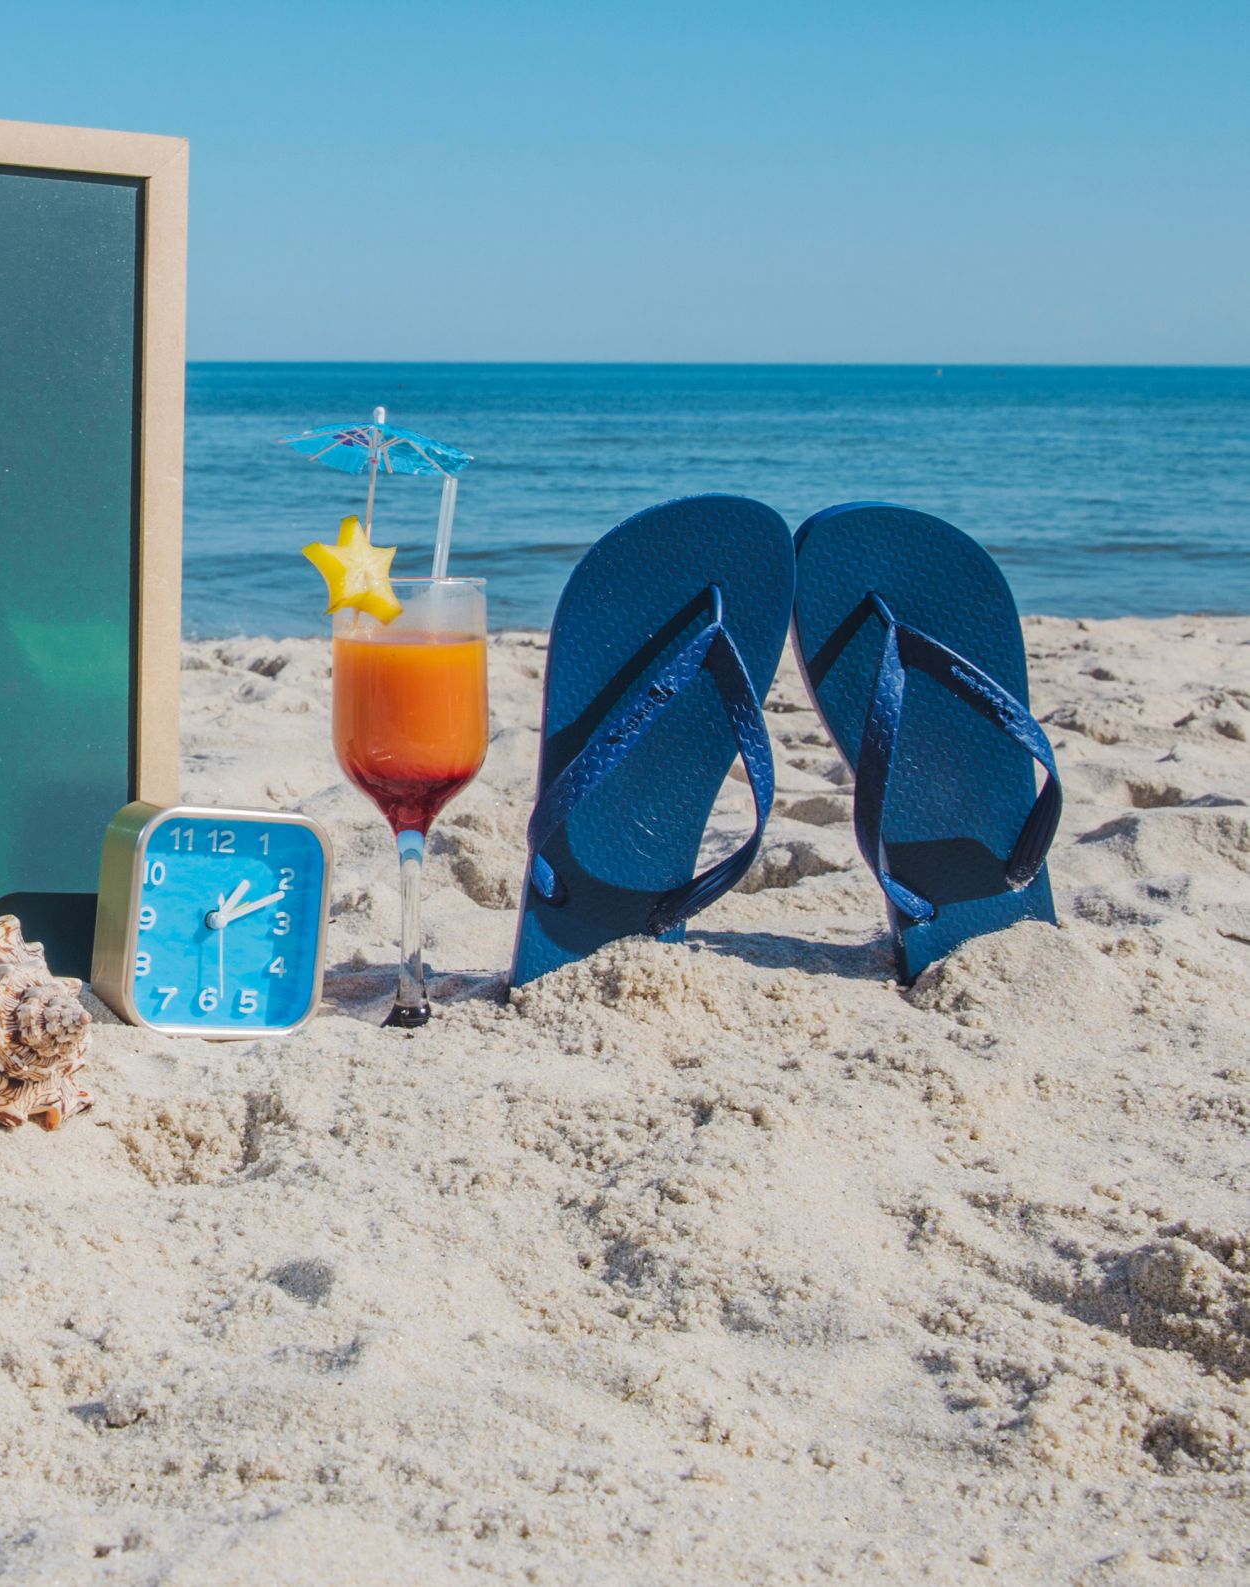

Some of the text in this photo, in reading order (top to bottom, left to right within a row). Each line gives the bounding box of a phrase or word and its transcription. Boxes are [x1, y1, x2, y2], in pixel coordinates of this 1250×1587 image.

[170, 827, 194, 851] 11
[207, 830, 235, 853] 12
[259, 832, 269, 856] 1
[143, 861, 166, 886] 10
[279, 867, 295, 890] 2
[138, 905, 157, 930] 9
[273, 911, 291, 936] 3
[269, 956, 286, 978] 4
[157, 987, 179, 1011] 7
[198, 987, 217, 1012] 6
[238, 990, 258, 1014] 5
